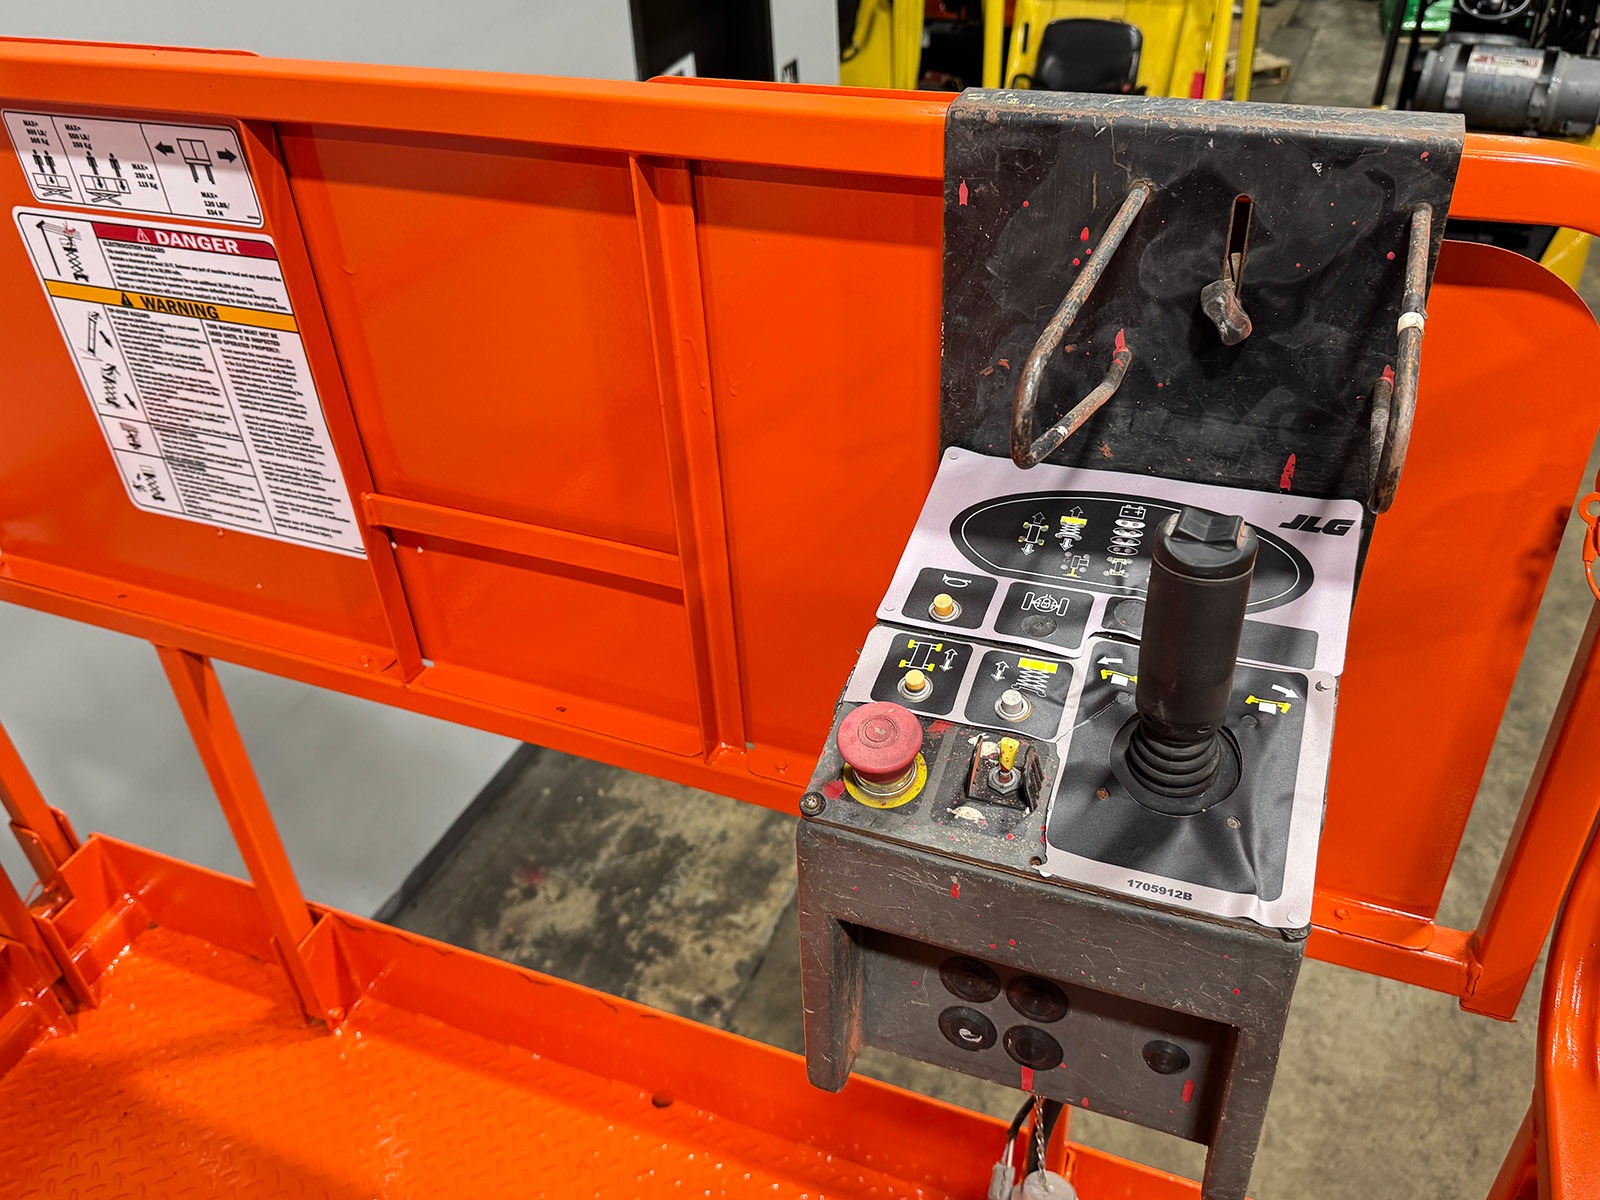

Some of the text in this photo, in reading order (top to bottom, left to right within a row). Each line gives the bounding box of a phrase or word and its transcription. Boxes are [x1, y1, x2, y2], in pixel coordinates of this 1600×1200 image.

[153, 230, 240, 254] DANGER
[139, 295, 220, 320] WARNING
[1278, 514, 1356, 536] JLG
[1127, 879, 1193, 901] 1705912B
